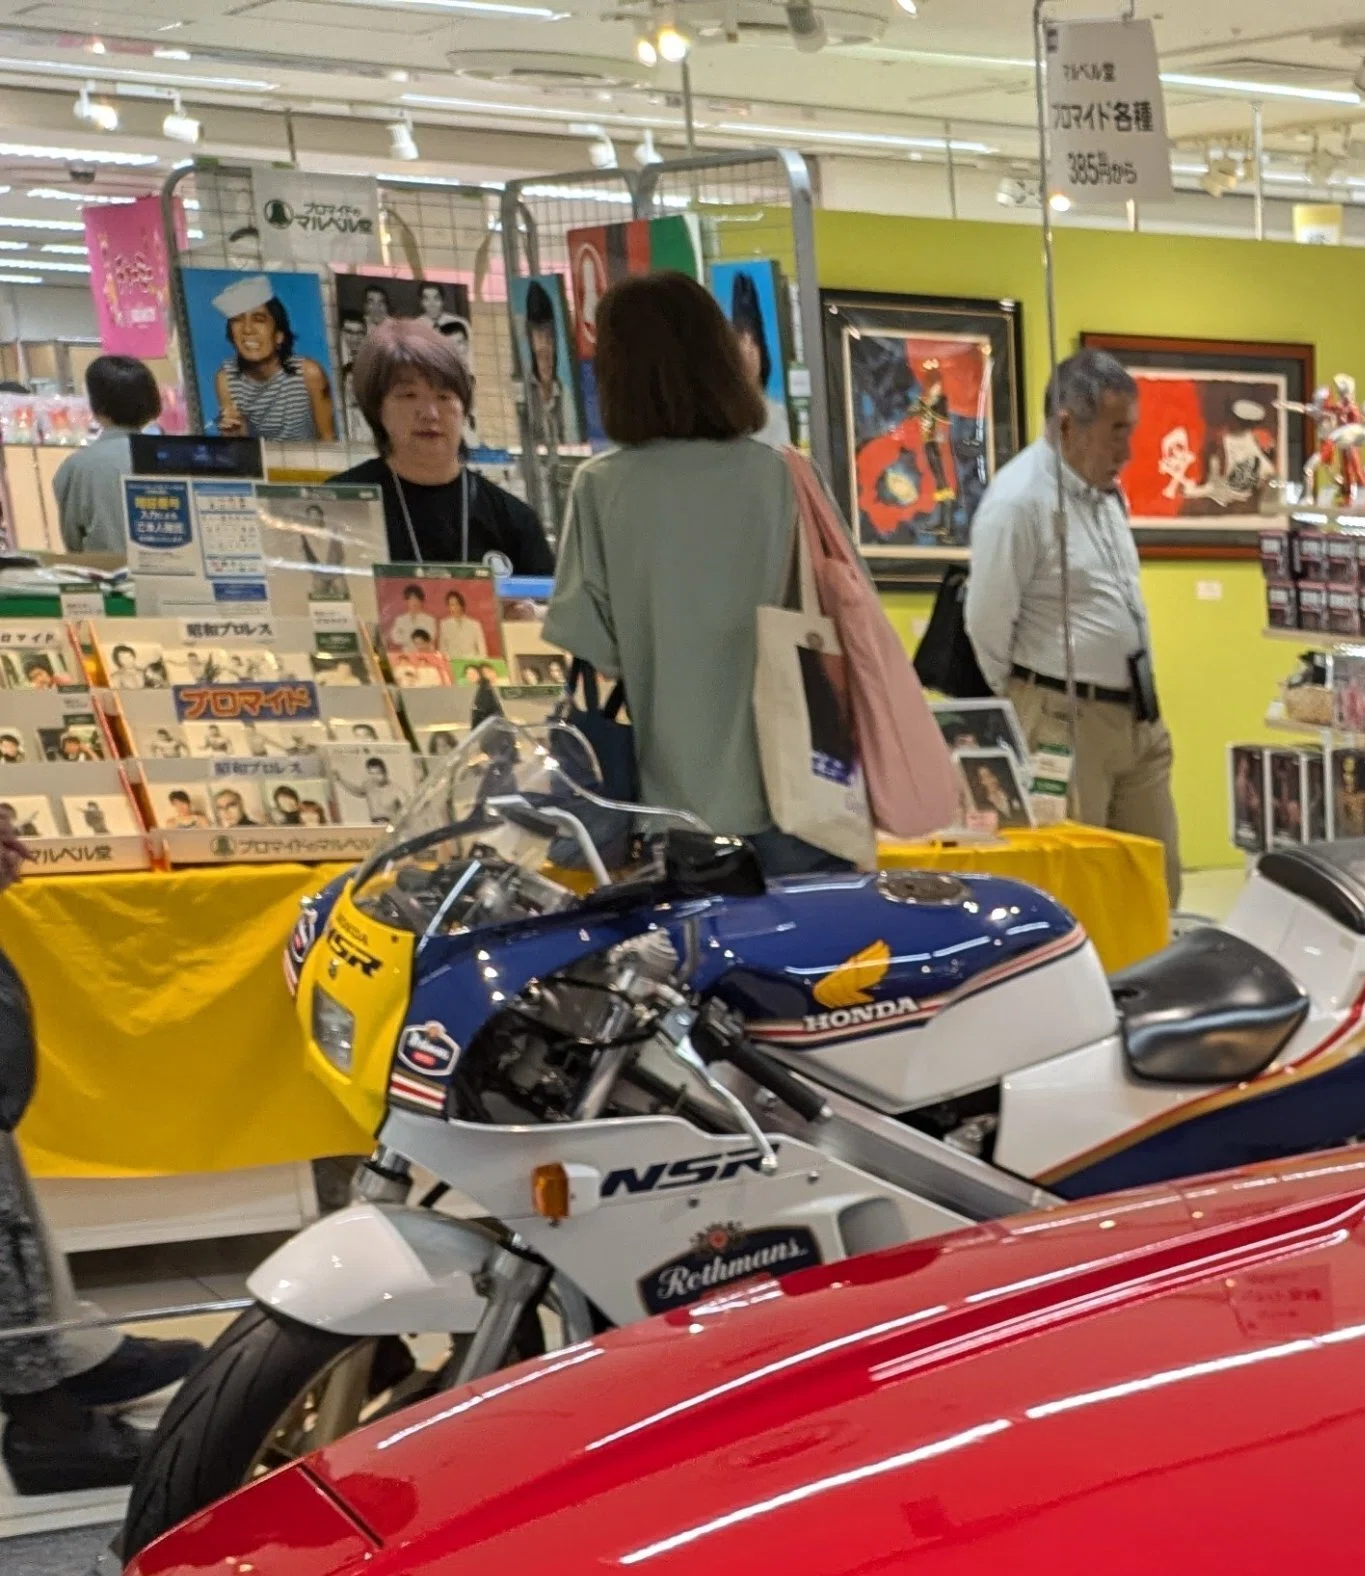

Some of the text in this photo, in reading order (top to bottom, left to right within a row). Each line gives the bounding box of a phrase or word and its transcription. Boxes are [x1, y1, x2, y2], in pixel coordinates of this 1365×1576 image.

[1063, 61, 1116, 83] マルベル堂
[294, 213, 374, 235] マルベル堂
[186, 623, 273, 638] 昭和プロレス
[214, 761, 303, 776] 昭和プロレス
[803, 996, 920, 1032] HONDA
[600, 1143, 781, 1198] NSR
